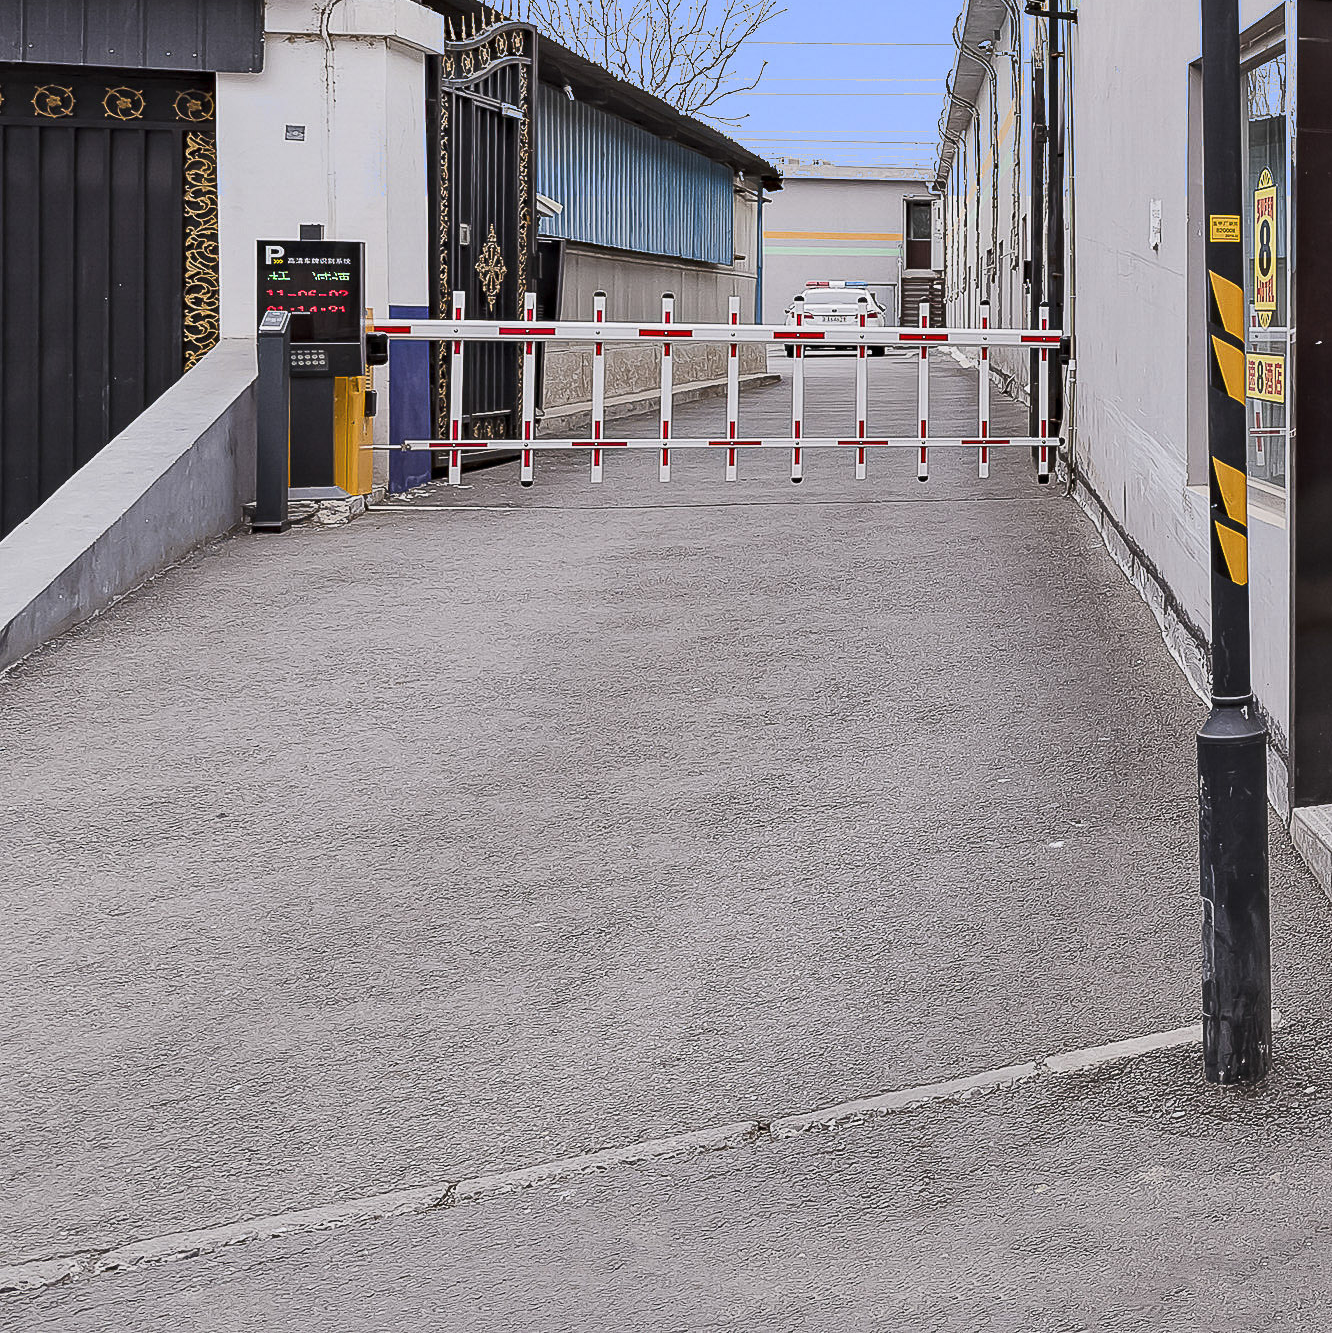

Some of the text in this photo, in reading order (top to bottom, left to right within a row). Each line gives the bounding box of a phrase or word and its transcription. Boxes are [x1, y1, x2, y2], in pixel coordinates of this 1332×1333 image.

[1258, 219, 1272, 277] 8
[1256, 274, 1275, 302] HOTEL
[1247, 360, 1283, 396] 速8酒店
